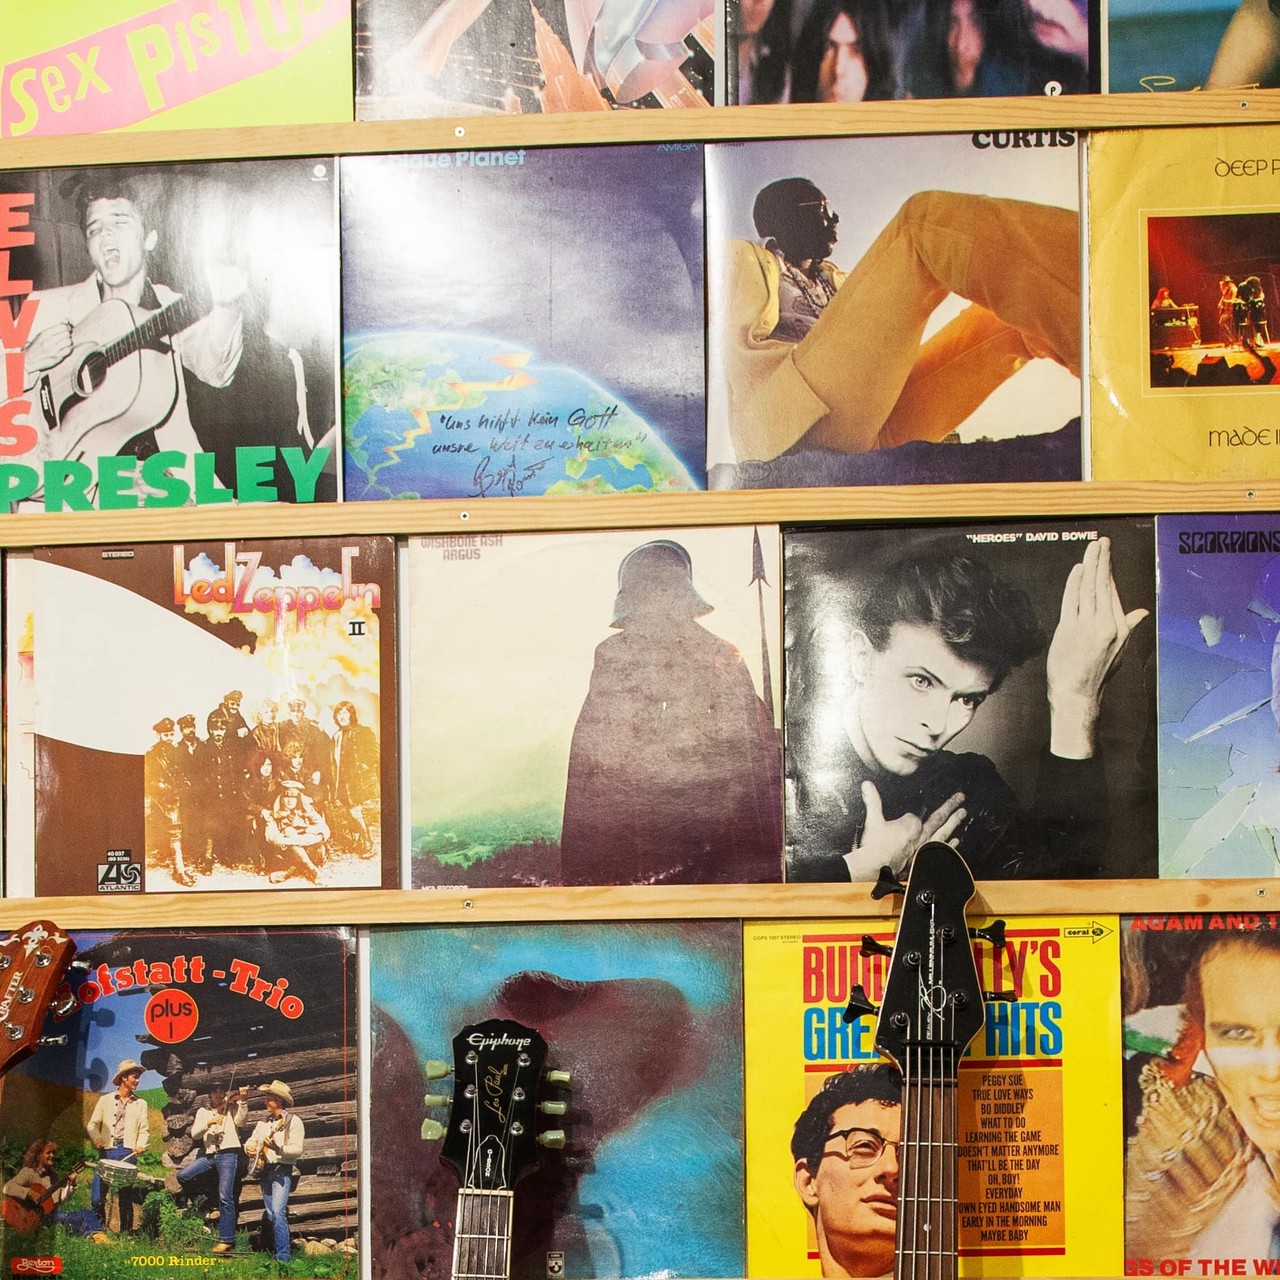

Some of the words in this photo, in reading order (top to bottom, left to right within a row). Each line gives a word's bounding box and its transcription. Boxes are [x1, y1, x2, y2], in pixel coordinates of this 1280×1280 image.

[972, 128, 1077, 150] CURTIS
[1214, 155, 1269, 178] DEEP
[1025, 532, 1060, 542] DAVID
[1061, 531, 1099, 541] BOWIE
[443, 549, 481, 561] ARGUS
[173, 542, 236, 605] Led
[1208, 912, 1261, 931] AND
[150, 998, 193, 1023] plus
[987, 1001, 1064, 1057] HITS
[466, 1032, 532, 1051] Epiphone
[982, 1075, 1006, 1086] PEGGY
[1008, 1074, 1023, 1086] SUE
[972, 1089, 991, 1100] TRUE
[993, 1089, 1012, 1100] LOVE
[1013, 1089, 1034, 1100] WAYS
[994, 1103, 1025, 1114] DIDDLEY
[981, 1117, 1001, 1128] WHAT
[965, 1131, 1002, 1143] LEARNING
[1004, 1131, 1018, 1143] THE
[1020, 1131, 1042, 1142] GAME
[991, 1145, 1021, 1156] MATTER
[1022, 1145, 1060, 1156] ANYMORE
[967, 1160, 996, 1171] THAT'LL
[1010, 1159, 1024, 1170] THE
[985, 1187, 1023, 1199] EVERYDAY
[978, 1202, 997, 1213] EYED
[999, 1201, 1041, 1213] HANDSOME
[1043, 1201, 1061, 1212] MAN
[962, 1216, 984, 1227] EARLY
[995, 1215, 1010, 1227] THE
[1012, 1215, 1047, 1226] MORNING
[980, 1230, 1006, 1241] MAYBE
[1008, 1229, 1029, 1241] BABY
[1159, 1258, 1193, 1276] OF
[1197, 1258, 1248, 1276] THE
